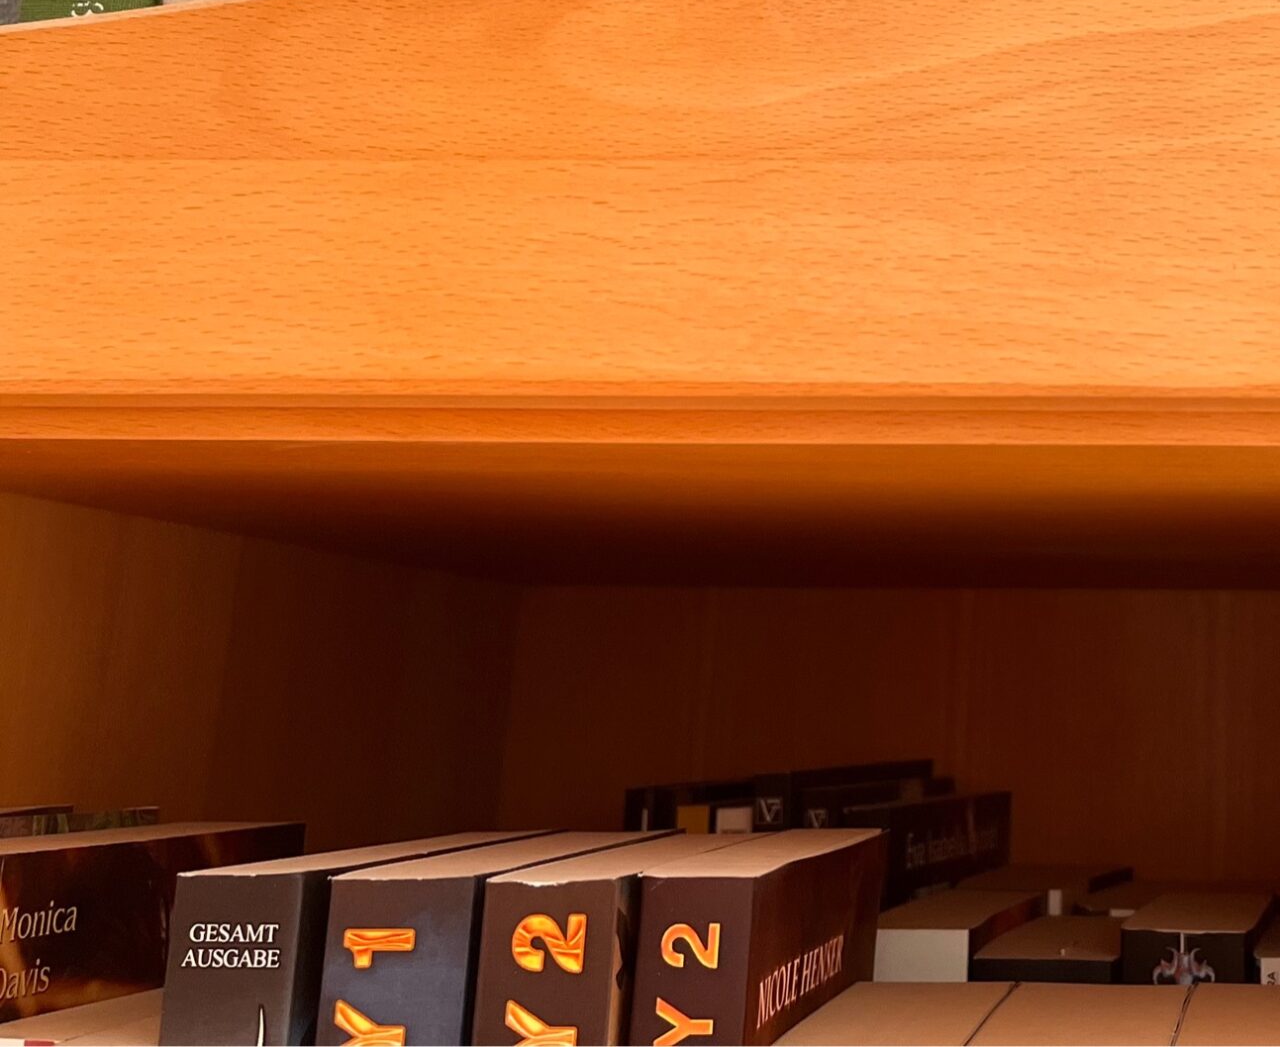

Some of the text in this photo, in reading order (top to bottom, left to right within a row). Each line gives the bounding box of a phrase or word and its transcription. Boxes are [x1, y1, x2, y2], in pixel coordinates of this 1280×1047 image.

[0, 900, 77, 944] Monica
[188, 923, 280, 944] GESAMT
[512, 913, 587, 974] 2
[181, 949, 281, 969] AUSGABE
[343, 928, 416, 969] 1
[660, 922, 720, 969] 2
[757, 956, 801, 1030] NICOLE
